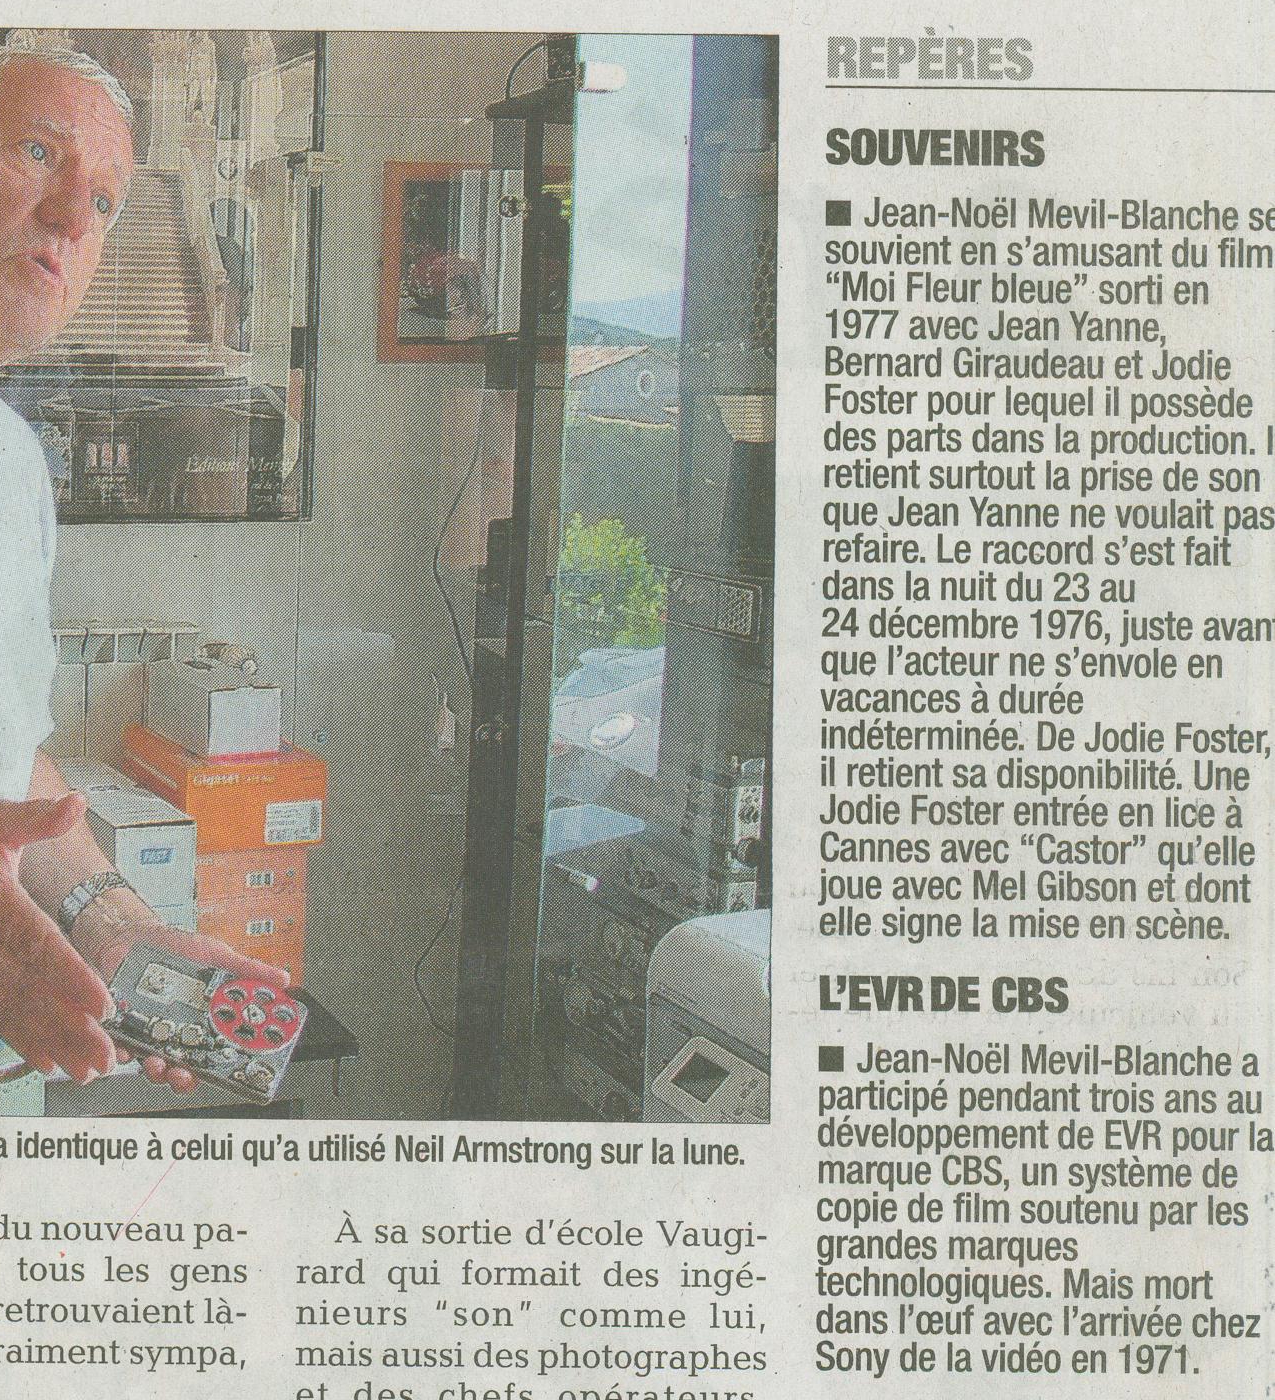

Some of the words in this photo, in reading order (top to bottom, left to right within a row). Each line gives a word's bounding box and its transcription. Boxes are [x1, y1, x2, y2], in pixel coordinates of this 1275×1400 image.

[826, 25, 1035, 81] REPÈRES
[825, 127, 1045, 167] SOUVENIRS
[825, 308, 899, 340] 1977
[908, 315, 978, 341] avec
[988, 310, 1060, 342] Jean
[1069, 310, 1166, 348] Yanne,
[825, 345, 942, 378] Bernard
[953, 346, 1104, 380] Giraudeau
[1114, 350, 1143, 380] et
[1152, 349, 1231, 381] Jodie
[819, 793, 901, 826] Jodie
[911, 794, 1005, 826] Foster
[1013, 794, 1108, 828] entrée
[1118, 803, 1154, 828] en
[1165, 796, 1215, 829] lice
[1225, 795, 1243, 829] à
[930, 976, 980, 1012] DE
[992, 976, 1069, 1014] CBS
[17, 1131, 138, 1166] identique
[146, 1131, 163, 1160] à
[171, 1133, 233, 1161] celui
[308, 1133, 386, 1162] utilisé
[395, 1134, 444, 1163] Neil
[452, 1135, 592, 1170] Armstrong
[600, 1142, 644, 1165] sur
[652, 1137, 675, 1165] la
[683, 1137, 745, 1166] lune.
[41, 1221, 184, 1242] nouveau
[193, 1223, 247, 1250] pa-
[816, 1228, 937, 1266] grandes
[948, 1236, 1078, 1268] marques
[295, 1341, 373, 1367] mais
[382, 1342, 465, 1368] aussi
[473, 1341, 529, 1369] des
[537, 1342, 767, 1378] photographes
[815, 1339, 890, 1379] Sony
[899, 1341, 936, 1373] de
[947, 1341, 973, 1373] la
[981, 1341, 1062, 1374] vidéo
[1071, 1349, 1107, 1374] en
[1118, 1344, 1199, 1375] 1971.
